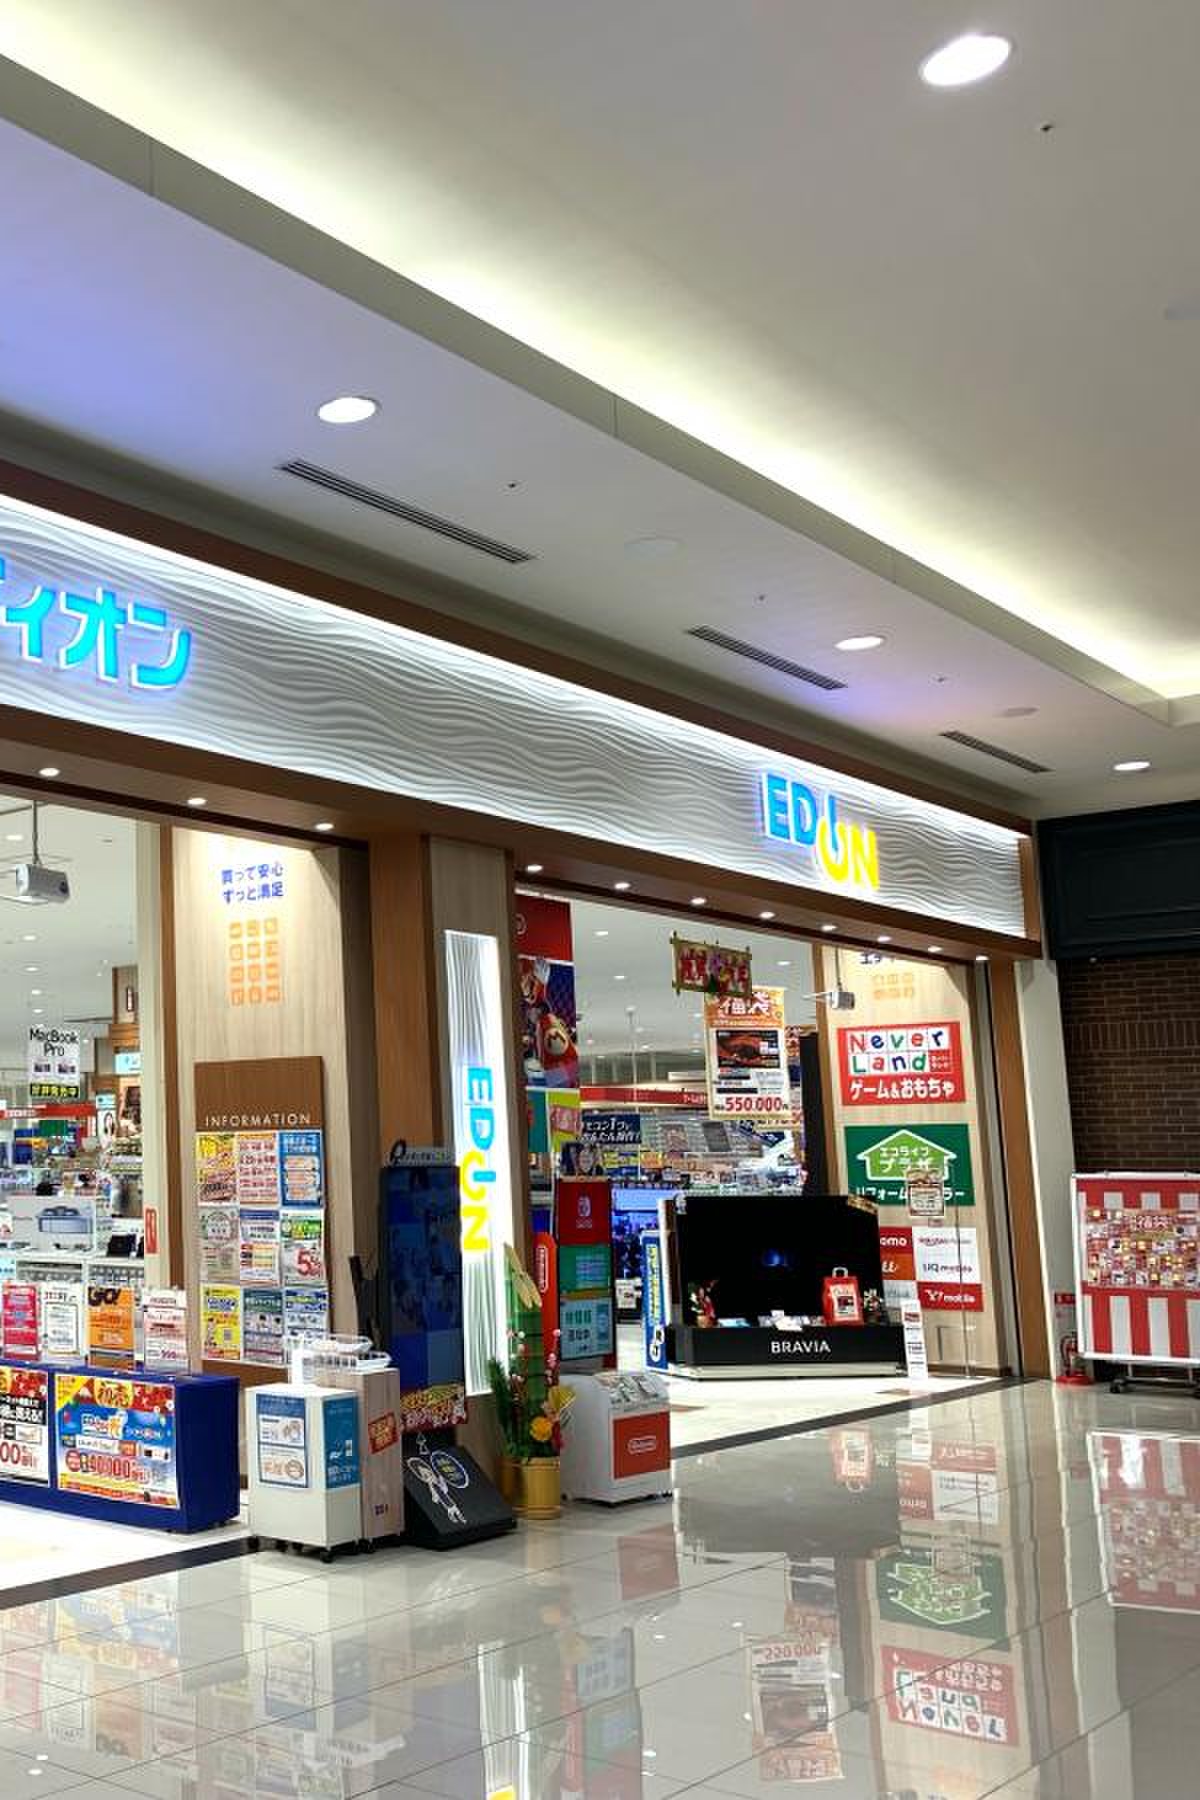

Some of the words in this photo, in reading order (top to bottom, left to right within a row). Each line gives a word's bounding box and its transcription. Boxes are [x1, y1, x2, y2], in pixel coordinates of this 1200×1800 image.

[762, 772, 880, 890] EDION
[30, 1027, 79, 1044] MacBook
[850, 1030, 944, 1053] Never
[44, 1042, 65, 1057] Pro
[852, 1054, 927, 1074] Land
[205, 1113, 310, 1127] INFORMATION
[460, 1066, 497, 1253] EDION
[771, 1340, 831, 1354] BRAVIA
